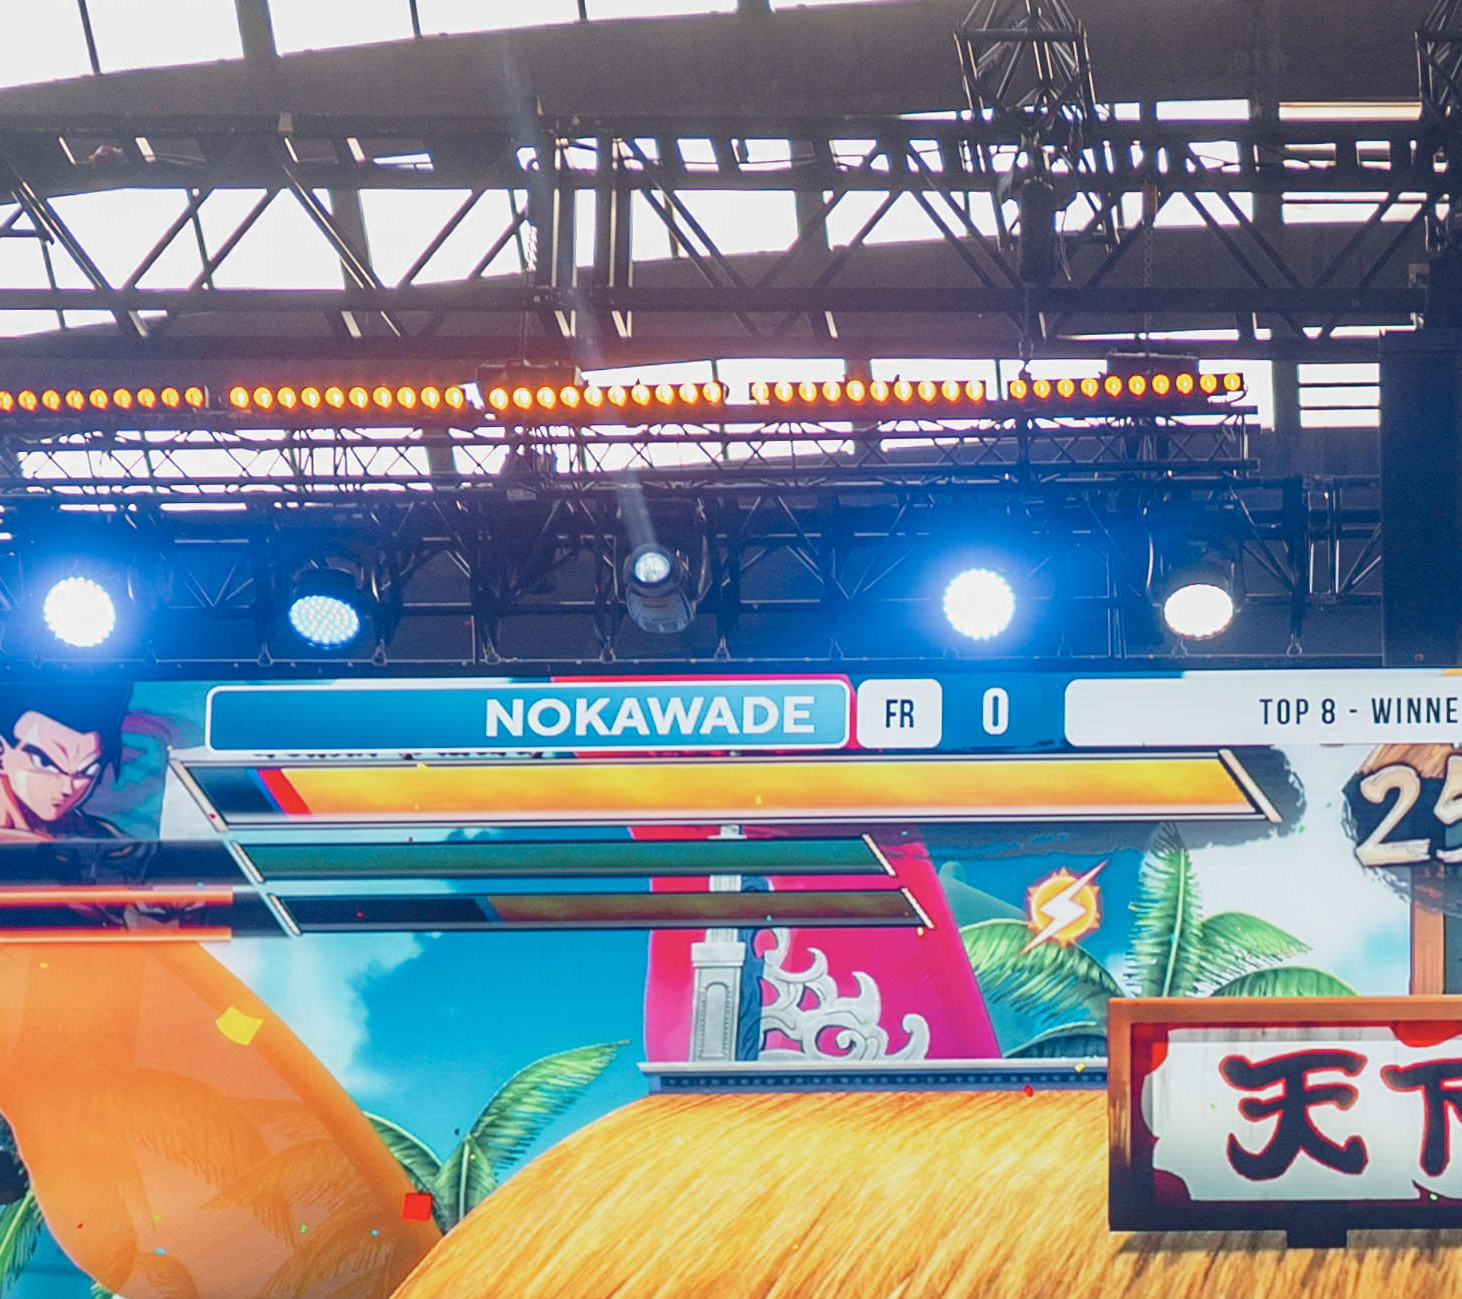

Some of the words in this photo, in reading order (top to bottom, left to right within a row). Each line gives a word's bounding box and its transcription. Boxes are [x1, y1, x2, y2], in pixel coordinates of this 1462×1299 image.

[484, 696, 816, 738] NOKAWADE
[884, 699, 915, 729] FR
[983, 687, 1009, 736] 0
[1259, 698, 1309, 724] TOP
[1321, 698, 1336, 724] 8
